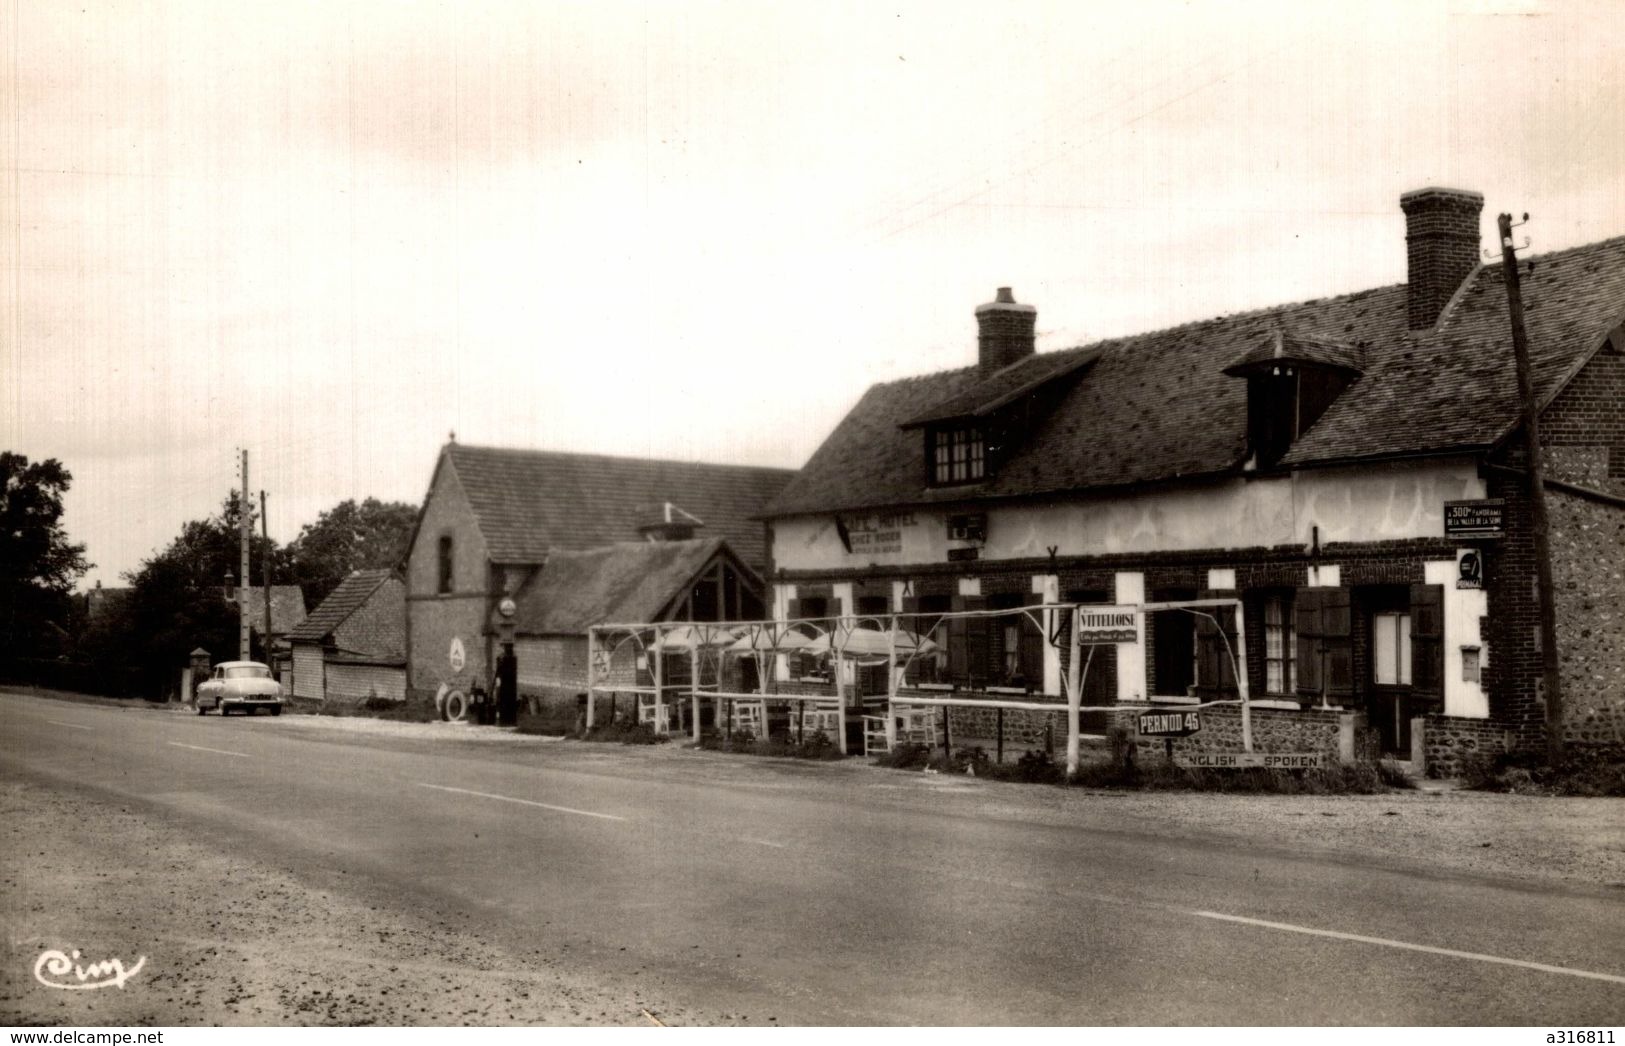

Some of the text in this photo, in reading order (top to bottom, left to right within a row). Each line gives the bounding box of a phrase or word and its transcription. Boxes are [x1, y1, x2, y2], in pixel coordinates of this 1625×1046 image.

[1081, 613, 1136, 628] VITTELLOISE
[1140, 712, 1199, 734] PERNOD 45
[1188, 756, 1237, 767] NGLISH
[1264, 756, 1318, 767] SPOKEN
